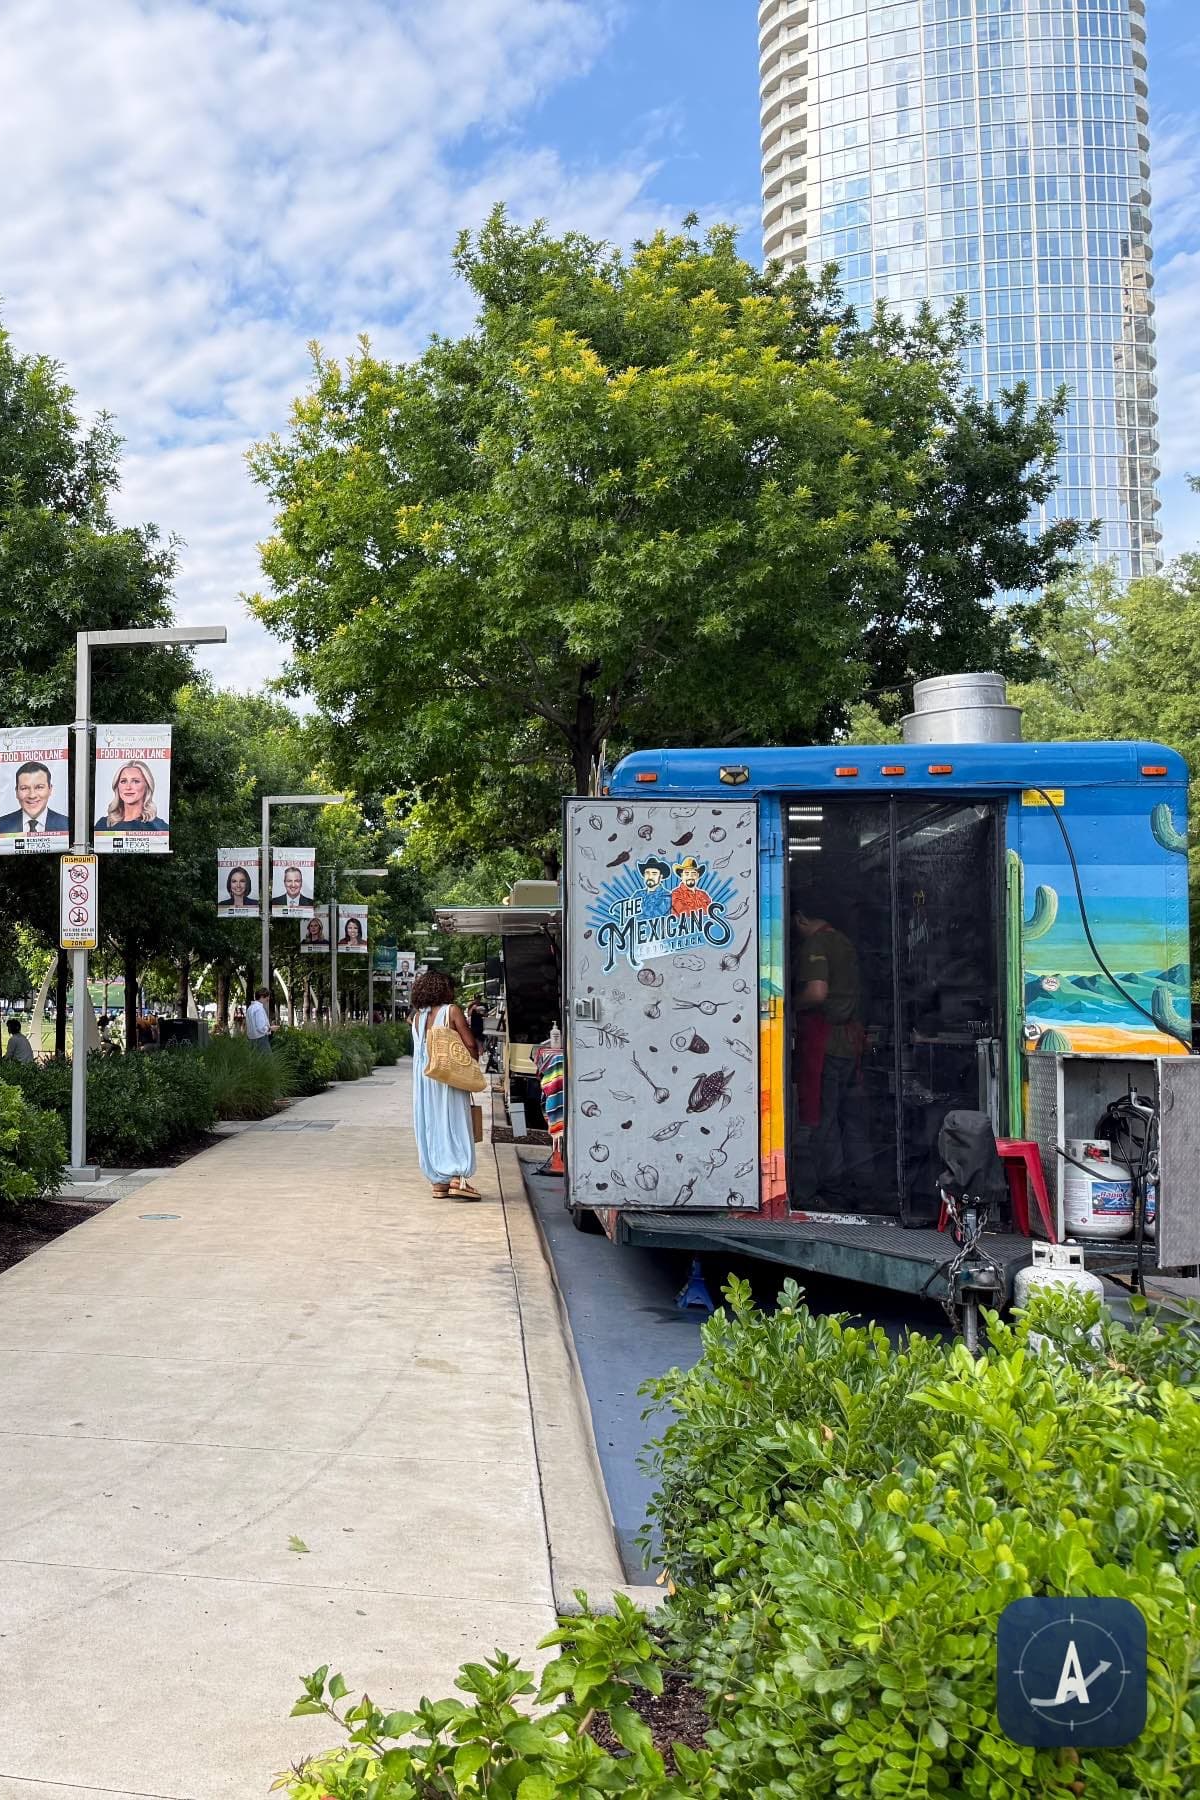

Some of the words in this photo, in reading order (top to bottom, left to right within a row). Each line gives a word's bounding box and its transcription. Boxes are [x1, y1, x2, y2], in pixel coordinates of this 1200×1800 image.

[0, 752, 19, 762] FOOD
[20, 751, 44, 761] TRUCK
[45, 750, 64, 760] LANE
[100, 748, 120, 759] FOOD
[120, 748, 145, 759] TRUCK
[146, 748, 166, 759] LANE
[609, 897, 642, 926] THE
[598, 902, 731, 973] MEXICANS
[669, 935, 703, 949] TRUCK
